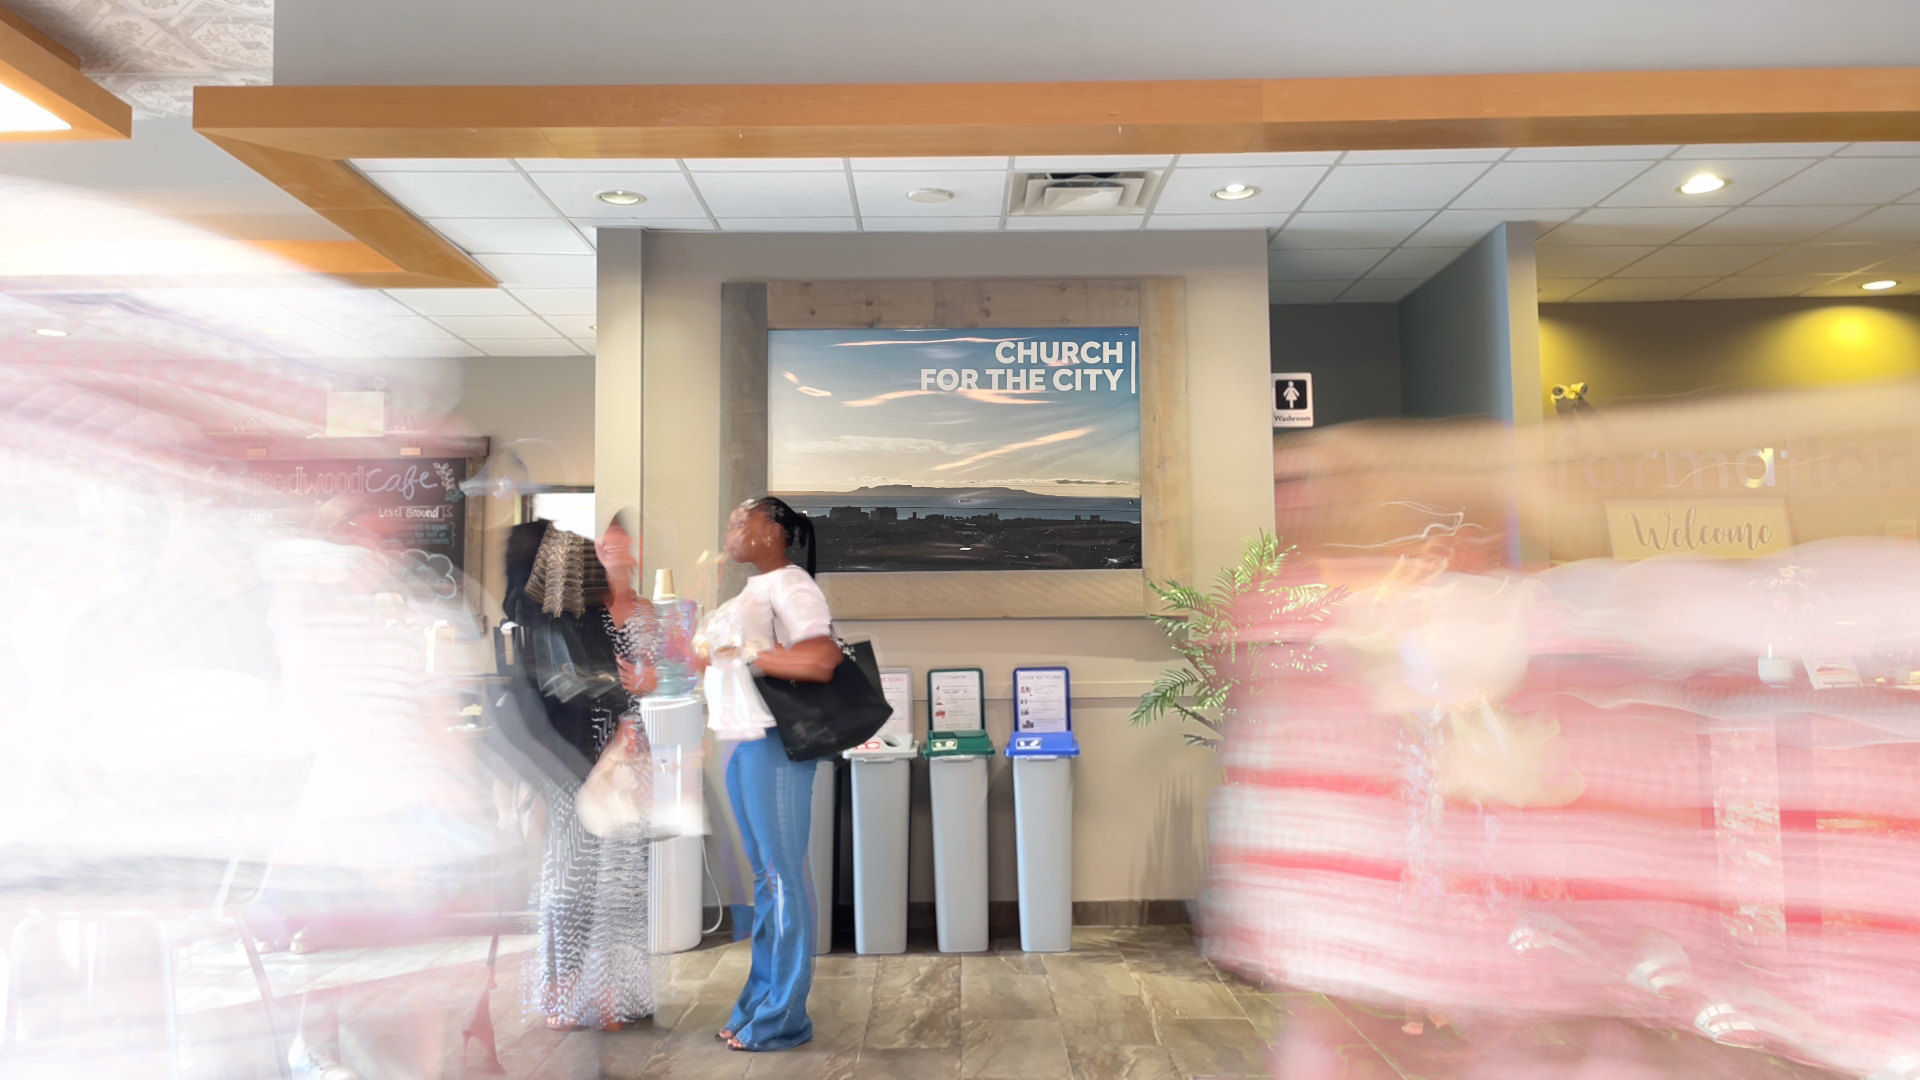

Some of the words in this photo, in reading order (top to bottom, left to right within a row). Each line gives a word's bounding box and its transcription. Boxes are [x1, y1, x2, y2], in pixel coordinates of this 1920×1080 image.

[995, 341, 1124, 364] CHURCH
[920, 368, 979, 391] FOR
[985, 368, 1046, 391] THE
[1052, 368, 1125, 391] CITY
[1273, 414, 1312, 422] Washroom
[378, 507, 402, 518] Level
[405, 507, 440, 519] Ground
[1626, 506, 1774, 552] Welcome
